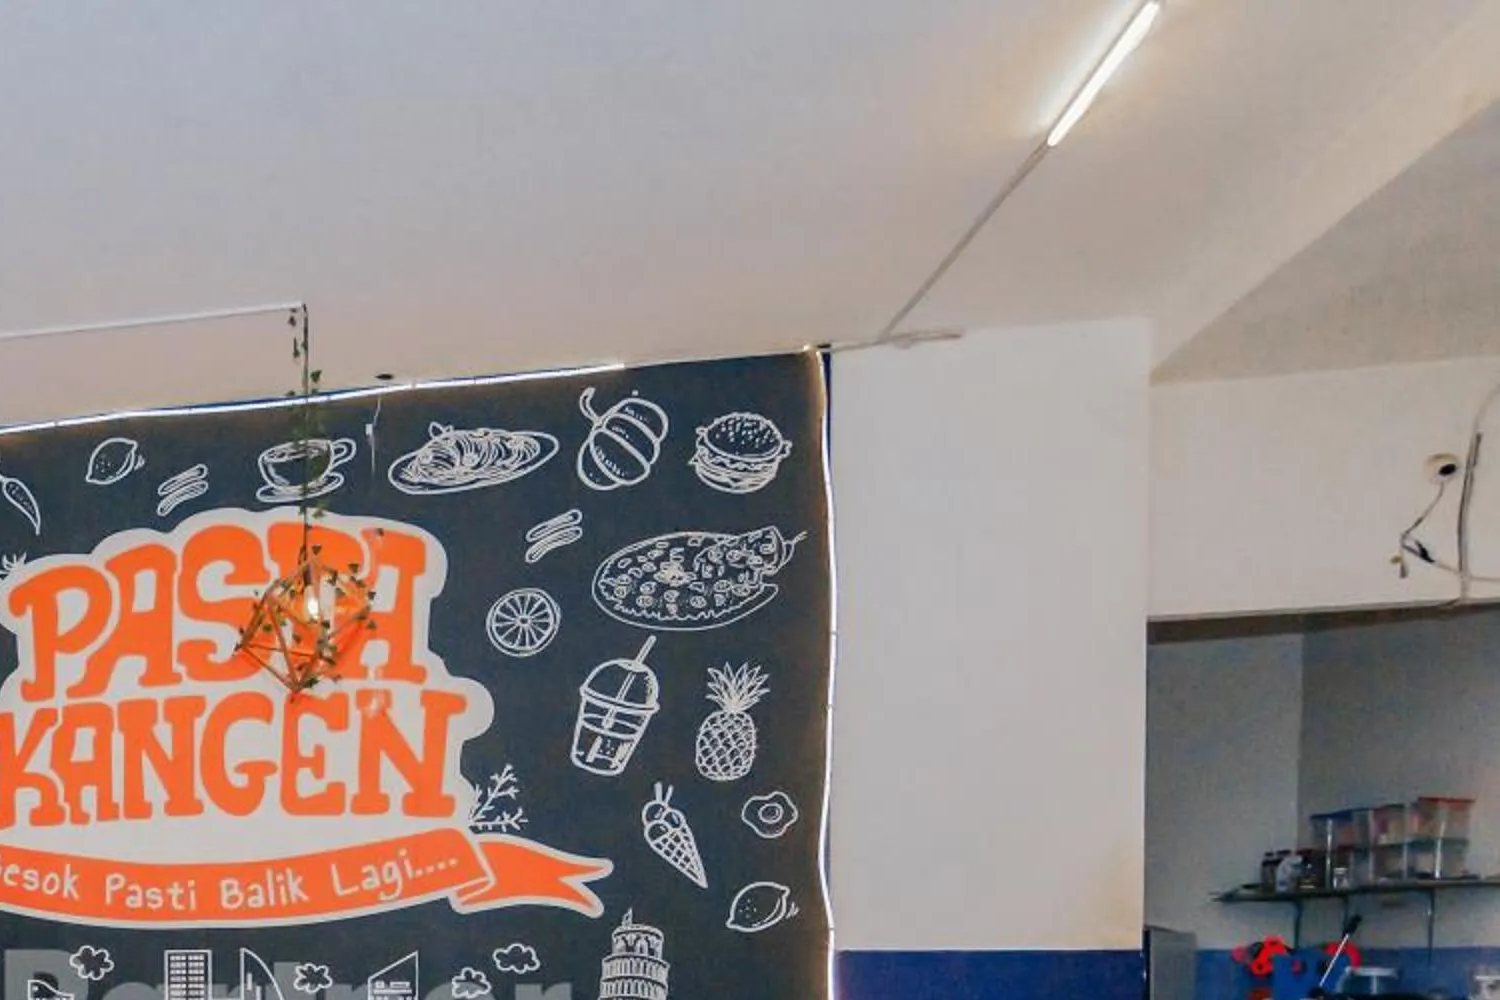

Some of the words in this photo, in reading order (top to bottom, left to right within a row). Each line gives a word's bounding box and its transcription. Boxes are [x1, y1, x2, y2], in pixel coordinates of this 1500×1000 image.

[8, 521, 428, 701] PASTA
[104, 871, 197, 911] Pasti
[219, 868, 305, 910] Balik
